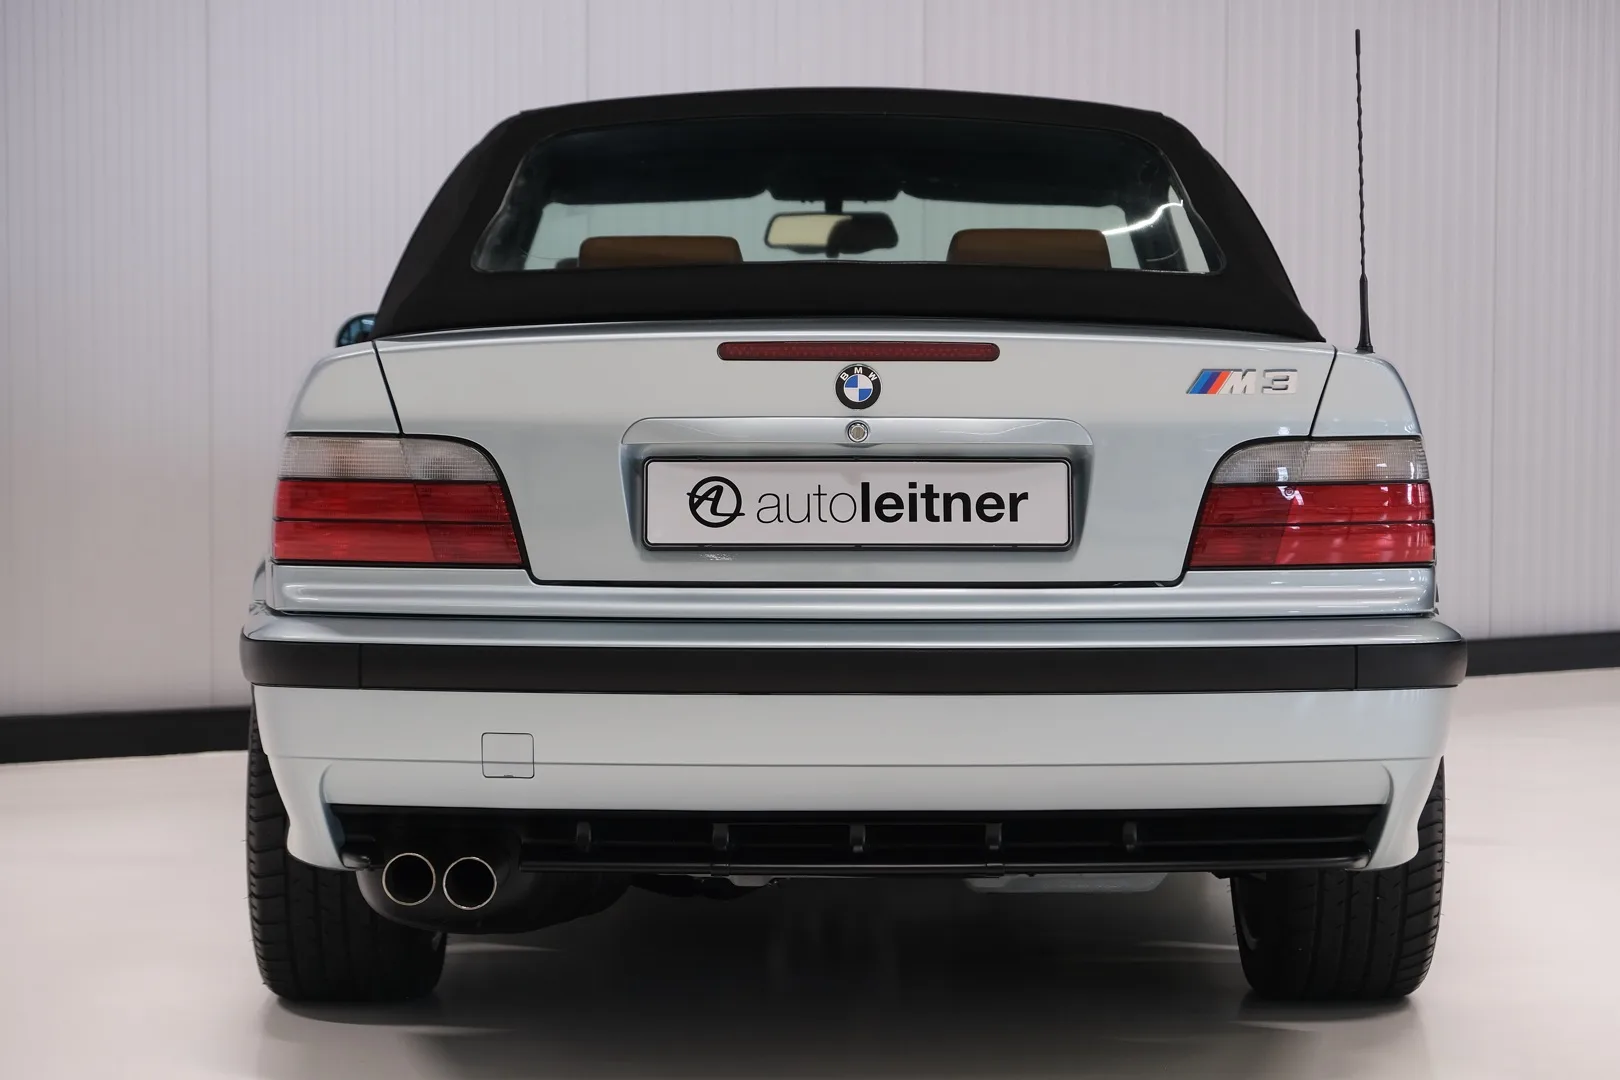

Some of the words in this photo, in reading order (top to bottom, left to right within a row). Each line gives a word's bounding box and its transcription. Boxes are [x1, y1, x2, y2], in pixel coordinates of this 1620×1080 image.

[839, 366, 878, 382] BMW
[1217, 368, 1298, 395] M3
[756, 481, 1029, 524] autoleitner
